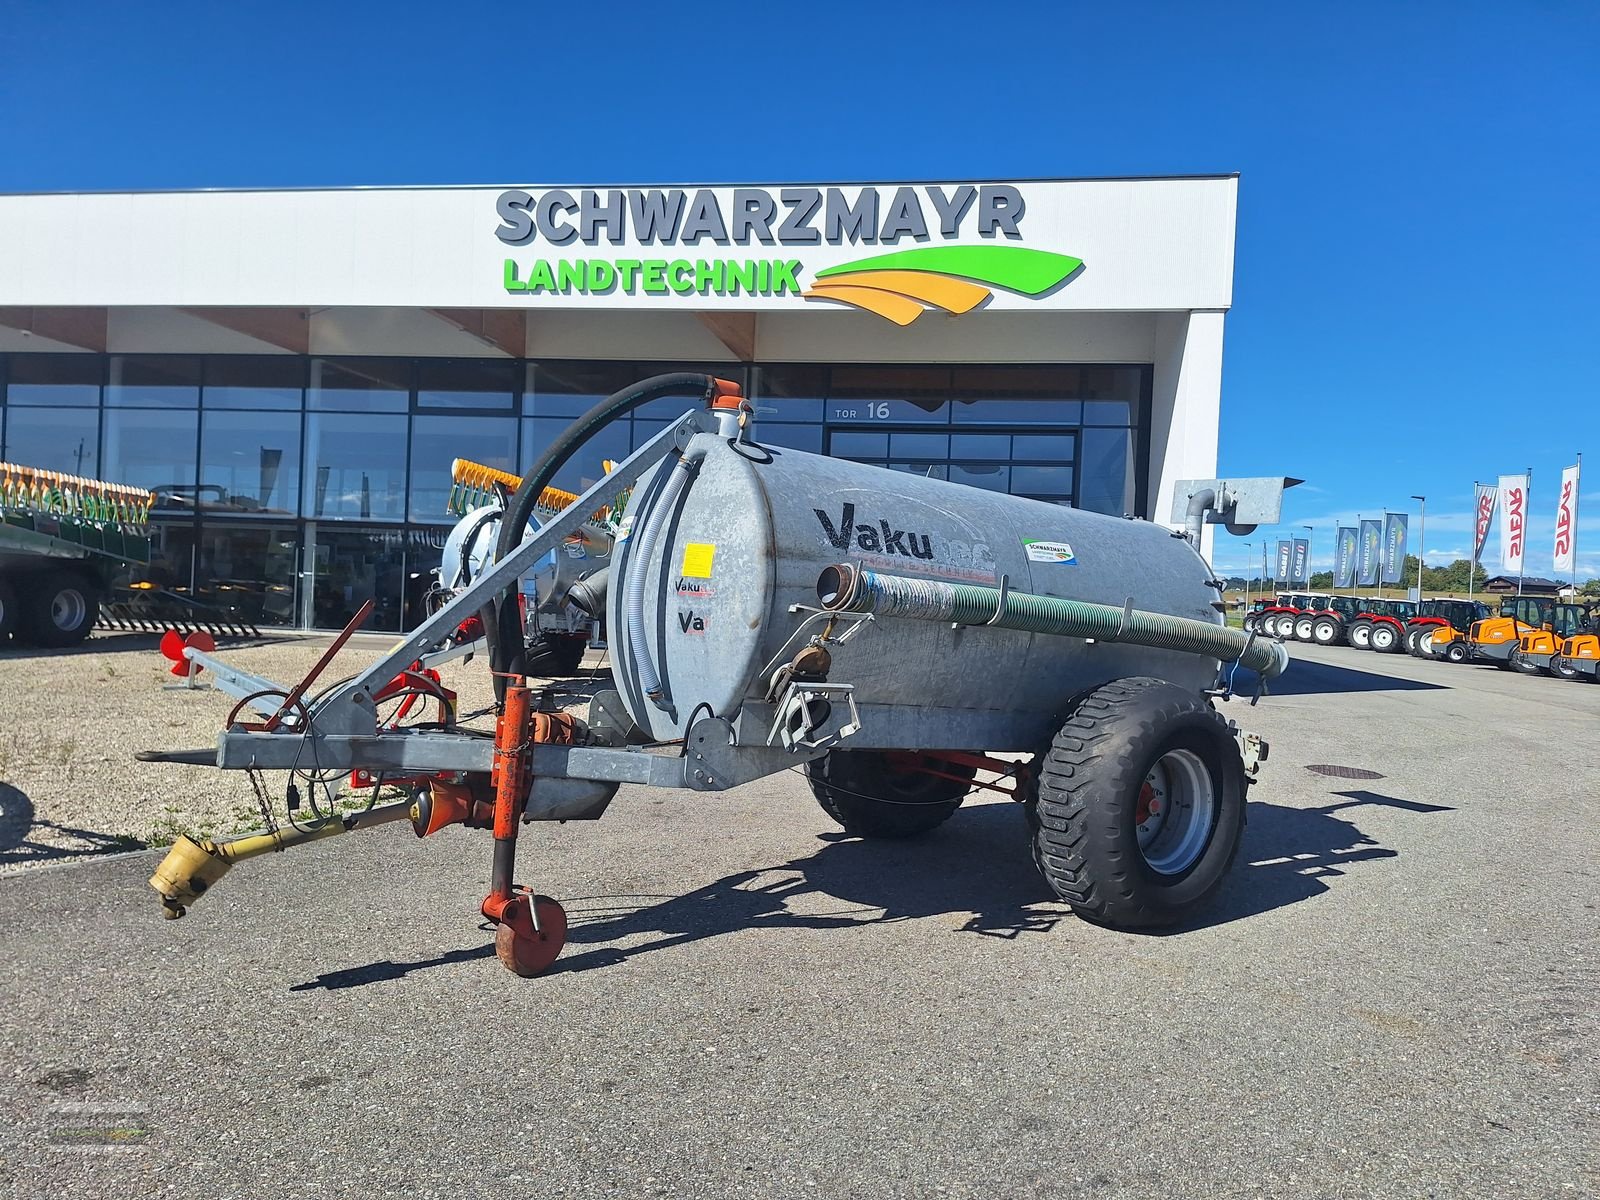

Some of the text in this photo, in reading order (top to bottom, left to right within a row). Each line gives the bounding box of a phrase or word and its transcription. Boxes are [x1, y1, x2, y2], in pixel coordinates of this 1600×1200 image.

[495, 184, 1026, 246] SCHWARZMAYR
[504, 259, 803, 297] LANDTECHNIK
[835, 402, 890, 419] TOR 16
[1294, 553, 1304, 577] CASE
[1388, 527, 1396, 574] SCHWARZMAYR
